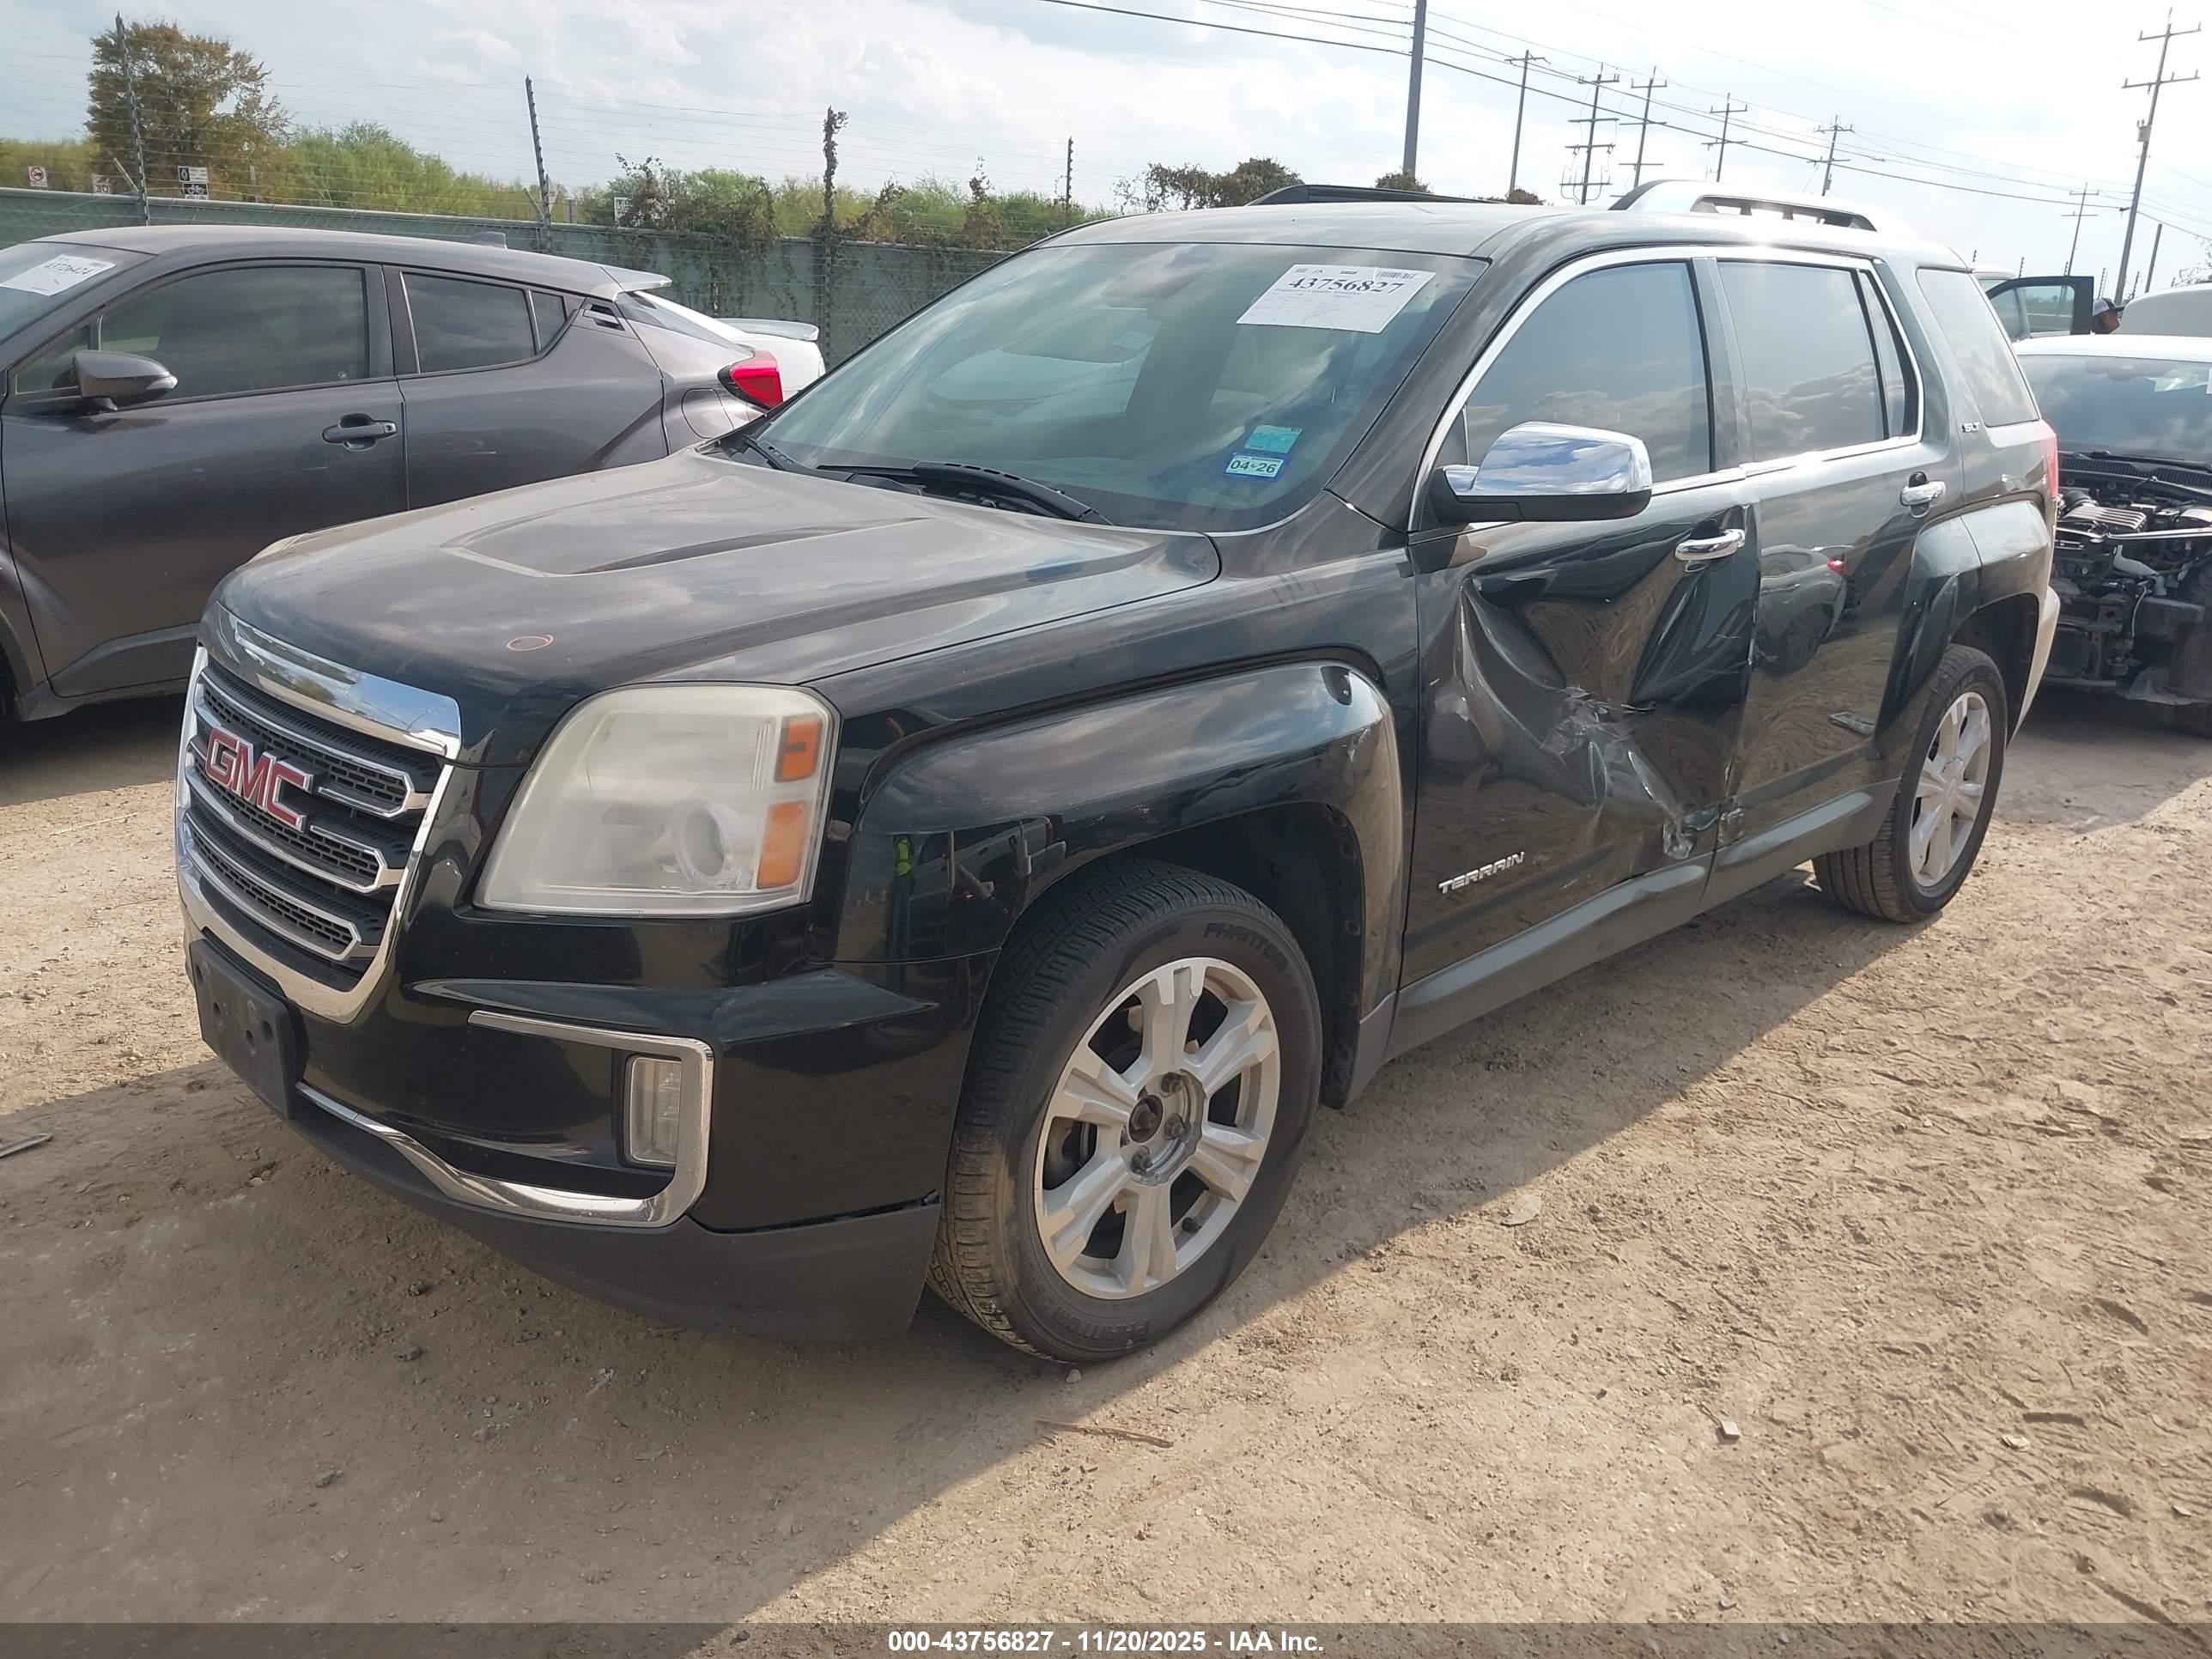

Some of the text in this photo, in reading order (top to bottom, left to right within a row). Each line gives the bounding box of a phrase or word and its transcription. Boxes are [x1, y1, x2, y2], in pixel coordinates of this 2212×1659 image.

[1288, 276, 1405, 295] 43756827
[1962, 422, 1980, 434] SLT
[206, 726, 314, 834] GMC
[1437, 851, 1526, 894] TERRAIN
